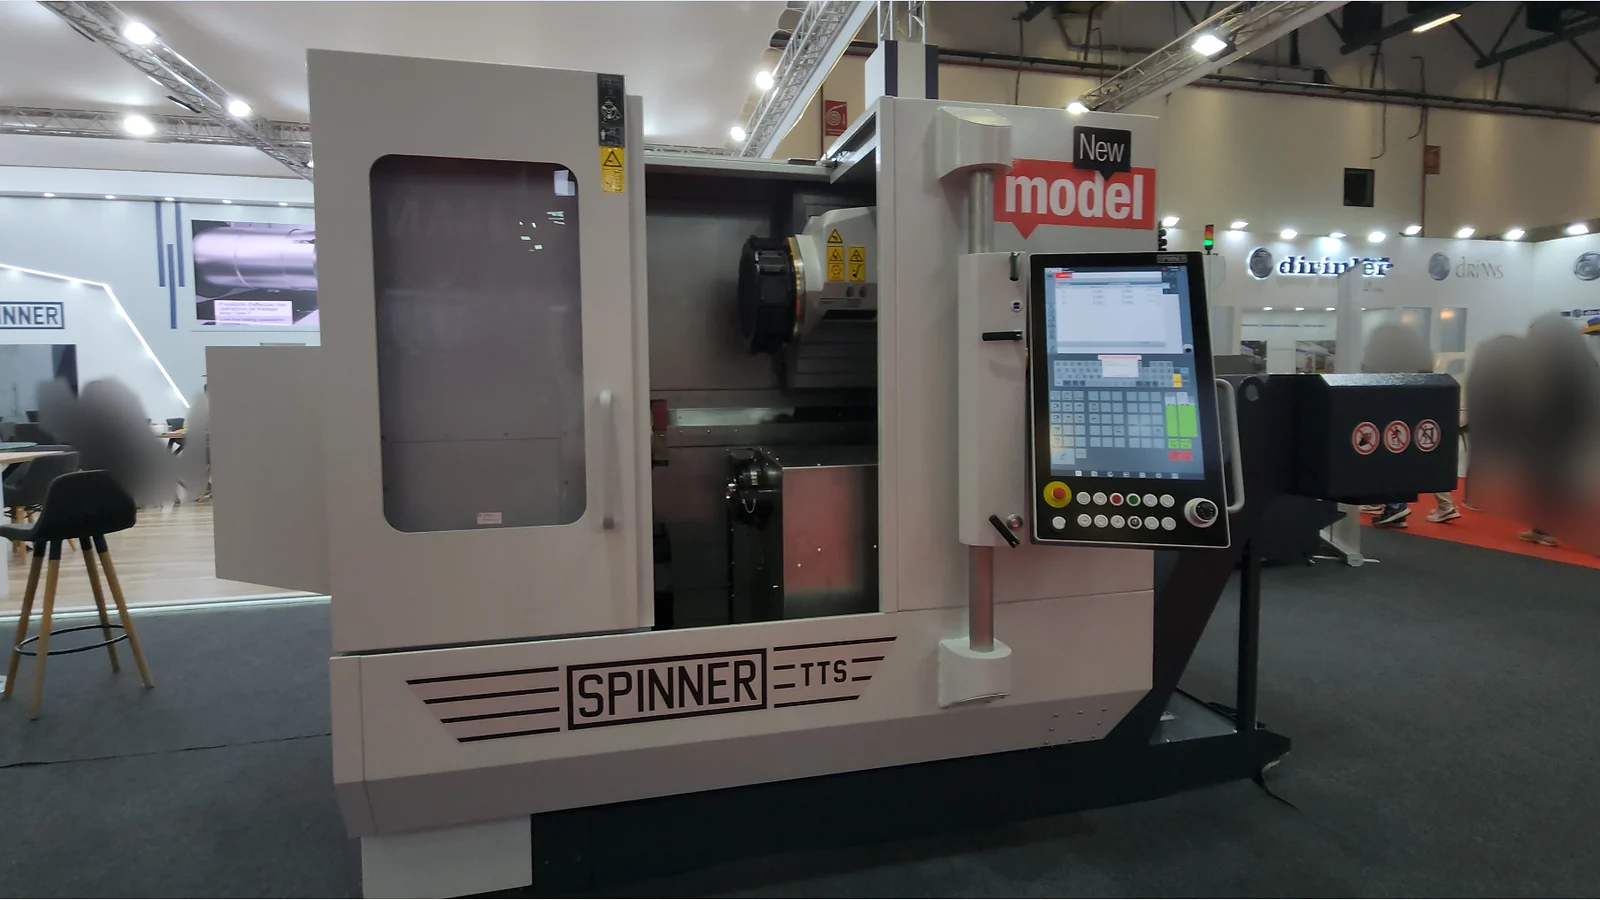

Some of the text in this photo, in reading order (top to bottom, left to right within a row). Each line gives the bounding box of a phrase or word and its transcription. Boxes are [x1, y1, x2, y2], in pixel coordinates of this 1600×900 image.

[1079, 133, 1125, 162] New
[1005, 171, 1144, 220] model
[0, 306, 59, 325] NNER
[578, 660, 847, 718] SPINNER TTS
